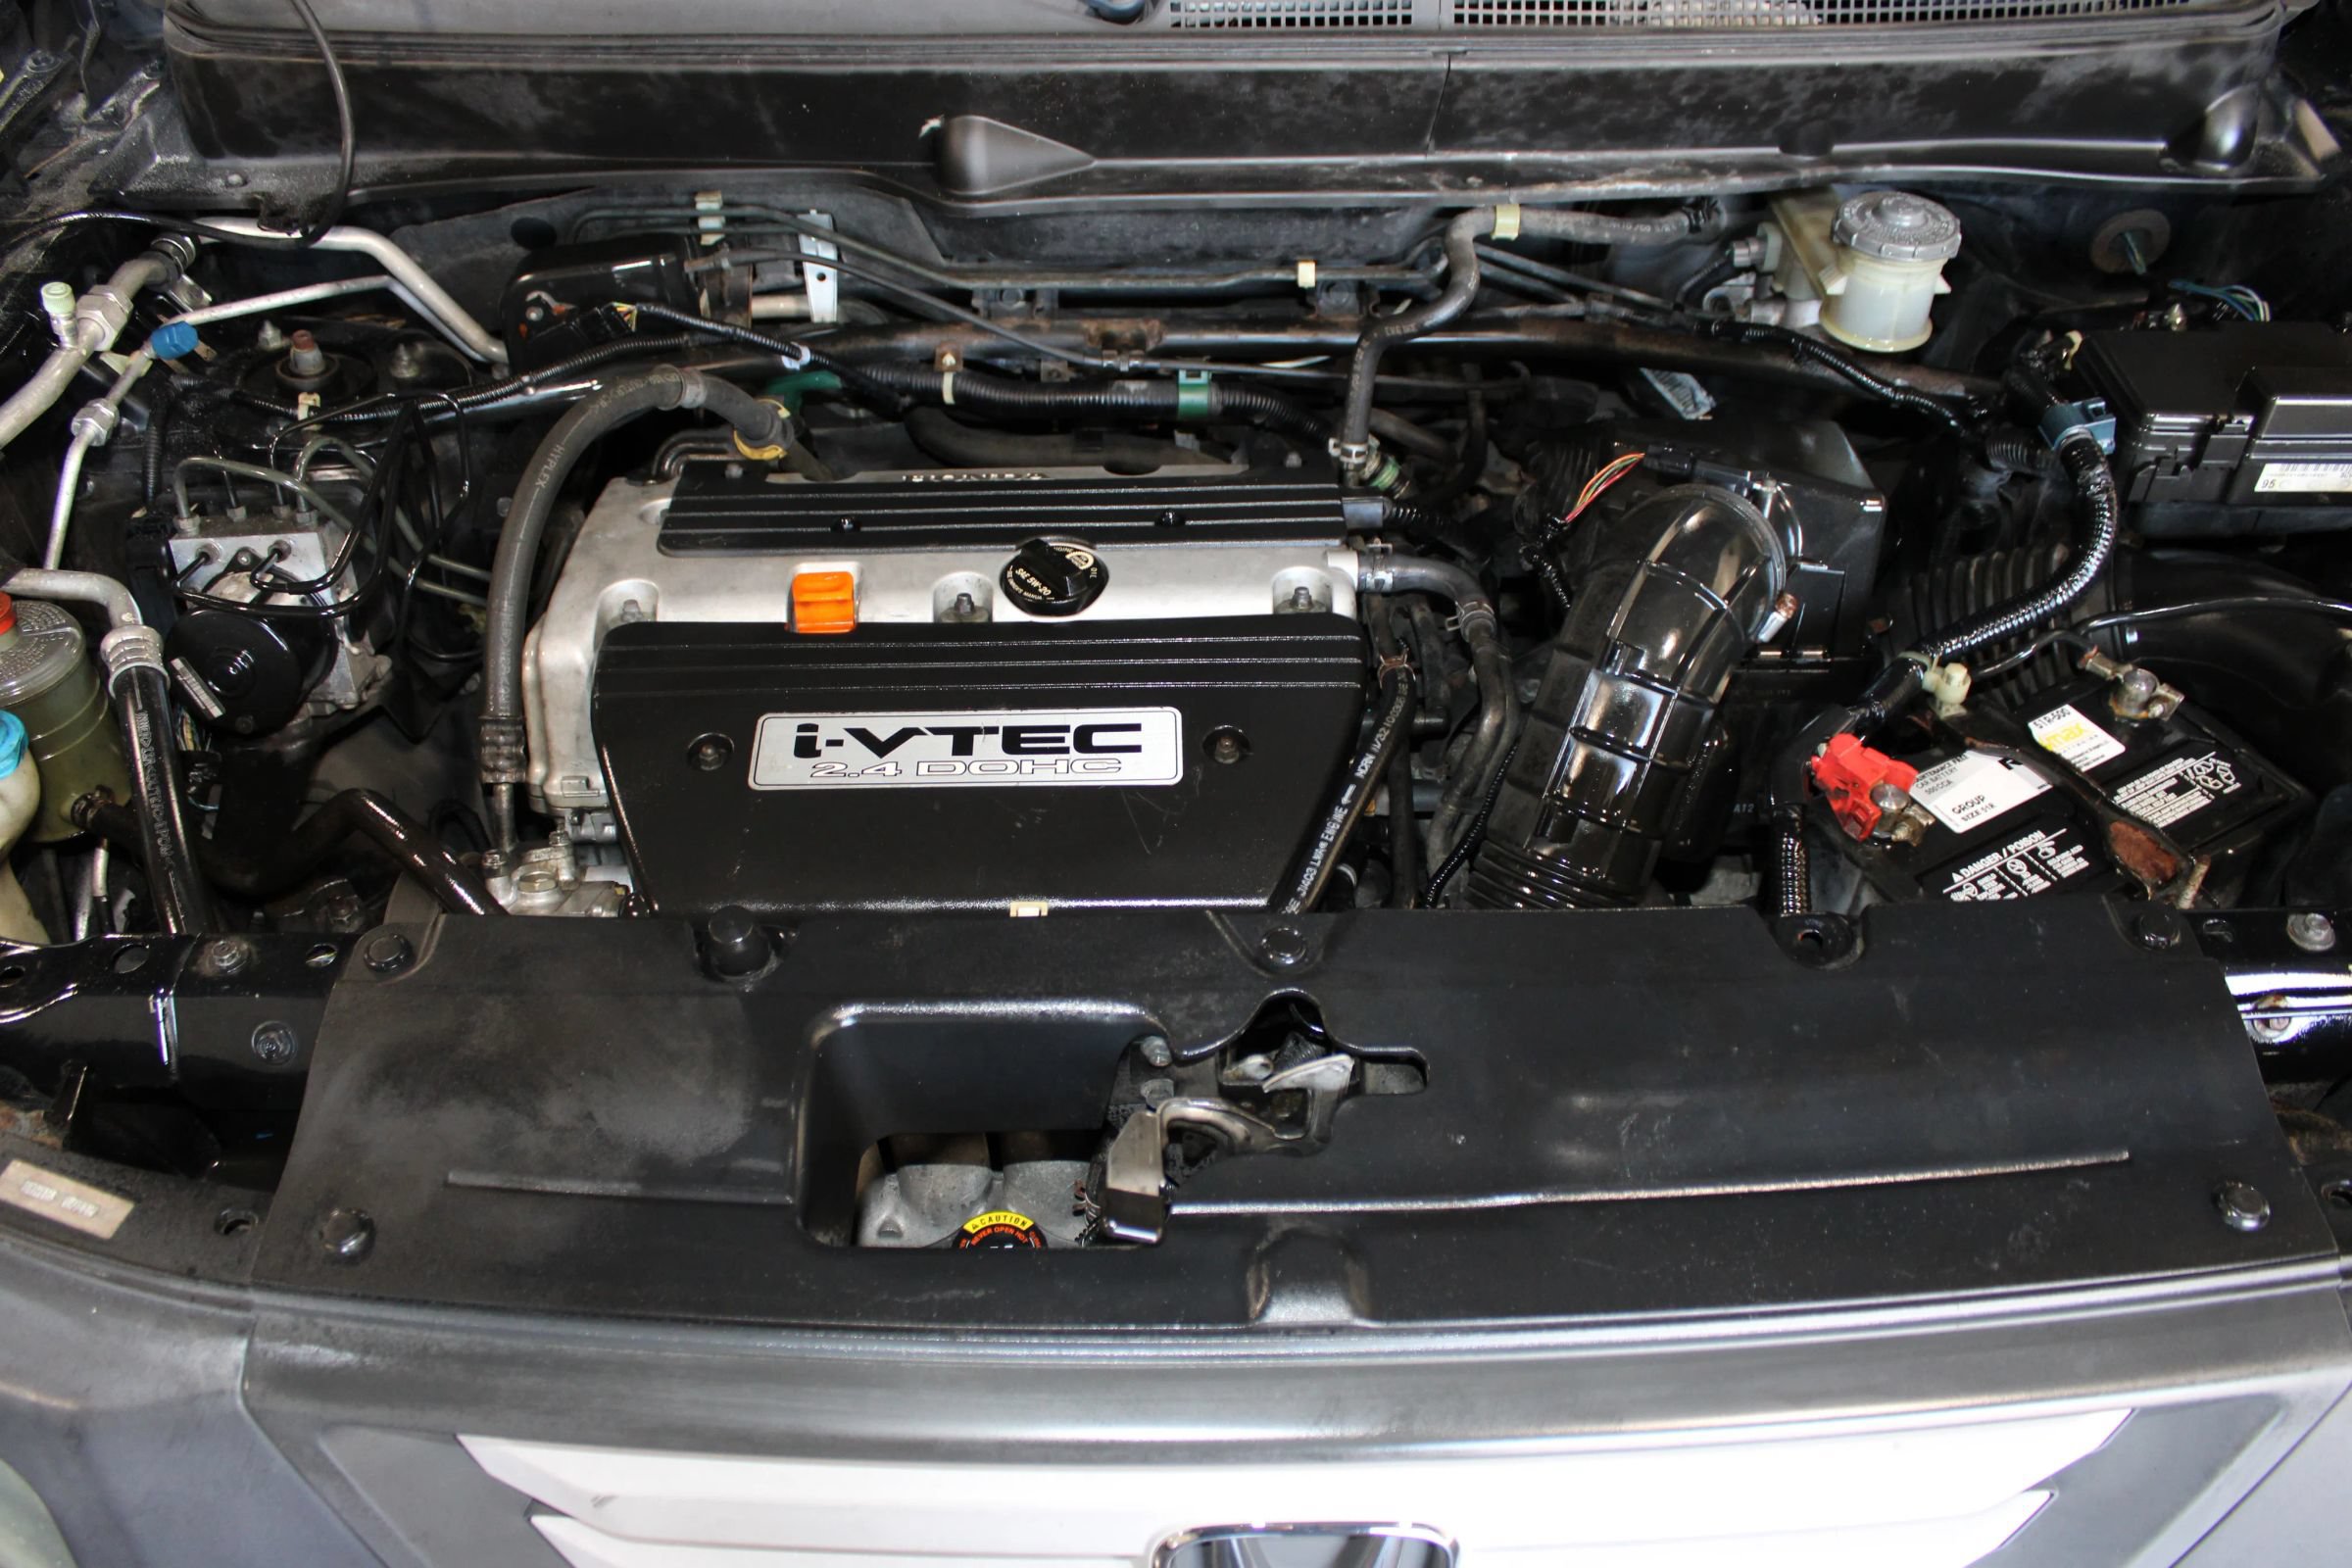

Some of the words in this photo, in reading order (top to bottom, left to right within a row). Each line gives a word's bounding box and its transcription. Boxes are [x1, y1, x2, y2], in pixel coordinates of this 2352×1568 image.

[535, 445, 565, 489] HYPLEX
[1015, 567, 1031, 580] SAE
[1026, 576, 1053, 597] 5W-20
[793, 722, 1143, 760] i-VTEC
[809, 760, 903, 778] 2.4
[915, 758, 1122, 776] DOHC
[1930, 766, 1959, 784] BATTERY
[1951, 793, 1986, 815] GROUP
[1961, 809, 1983, 823] SIZE
[1960, 852, 2004, 879] DANGER
[2007, 829, 2047, 855] POISON
[979, 1214, 1029, 1228] CAUTION
[969, 1226, 994, 1247] NEVER
[994, 1225, 1016, 1236] OPEN
[1014, 1230, 1030, 1245] HOT
